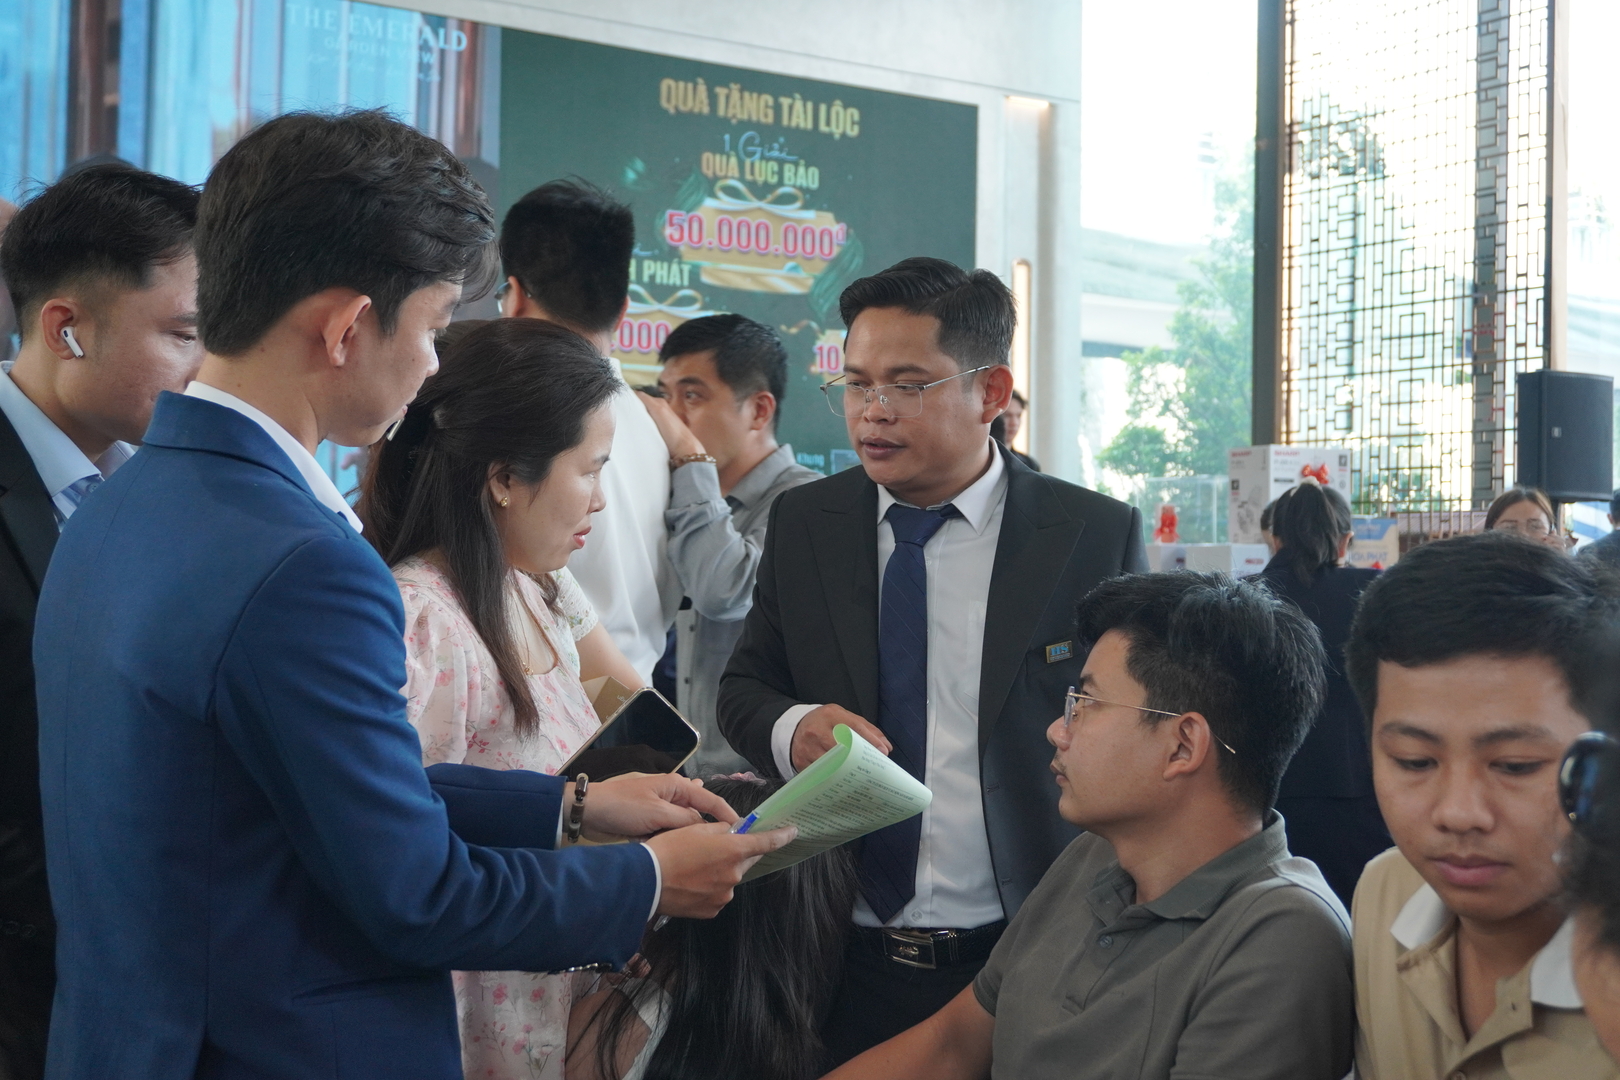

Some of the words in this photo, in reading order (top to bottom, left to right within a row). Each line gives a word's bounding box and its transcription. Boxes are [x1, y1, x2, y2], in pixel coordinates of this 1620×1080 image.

[286, 4, 338, 31] THE
[350, 13, 467, 51] EMERALD
[660, 77, 710, 115] QUÀ
[714, 82, 774, 125] TẶNG
[778, 93, 814, 131] TÀI
[818, 99, 860, 141] LỘC
[724, 133, 731, 152] 1
[702, 151, 740, 179] QUÀ
[744, 158, 779, 187] LỤC
[783, 159, 819, 190] BẢO
[642, 258, 692, 287] PHÁT
